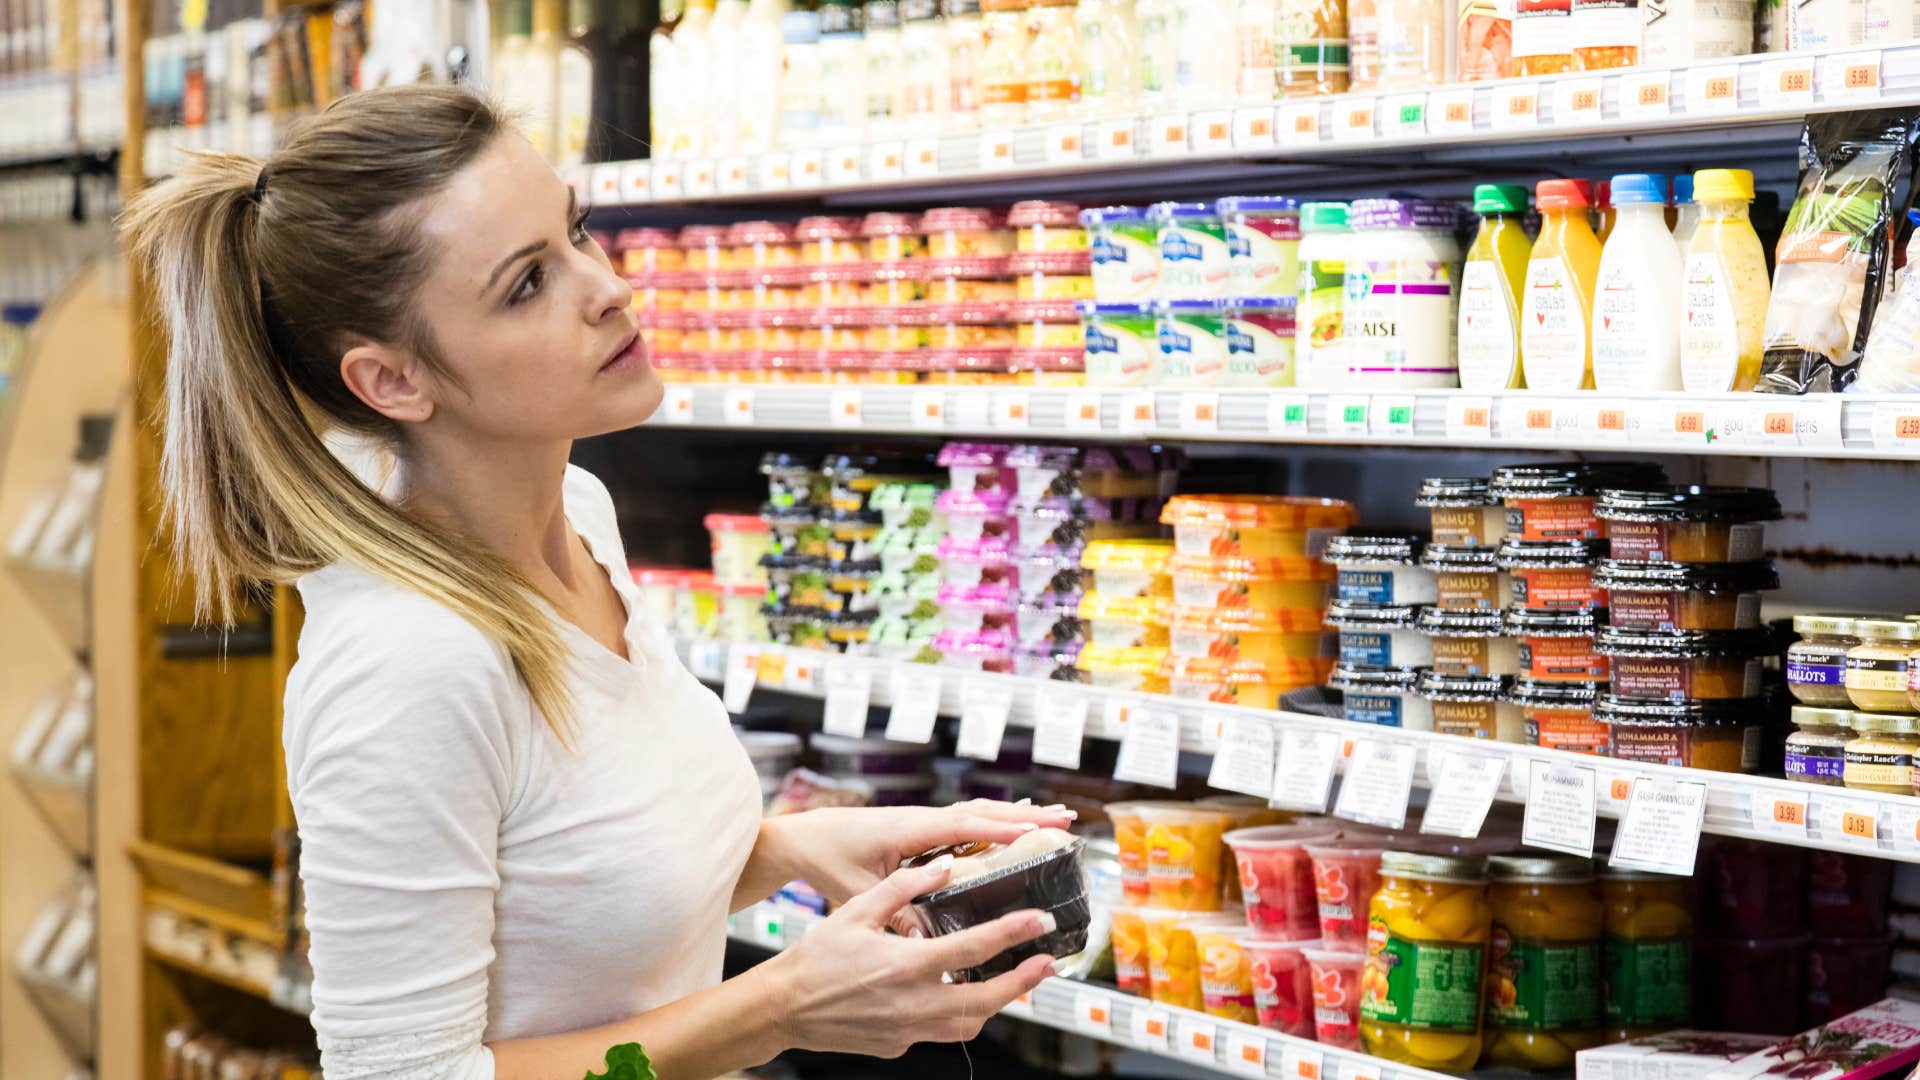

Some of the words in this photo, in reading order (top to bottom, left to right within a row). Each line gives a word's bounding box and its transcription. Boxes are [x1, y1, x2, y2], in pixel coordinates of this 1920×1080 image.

[1787, 75, 1804, 90] 5.99
[1851, 69, 1868, 85] 5.99
[1711, 82, 1728, 97] 5.99
[1680, 415, 1697, 432] 6.99
[1724, 418, 1744, 435] goo
[1769, 418, 1786, 433] 4.49
[1902, 419, 1920, 435] 2.59
[1618, 664, 1680, 674] MUHAMMARA
[1788, 669, 1826, 683] HALLOTS
[1616, 732, 1678, 742] MUHAMMARA
[1873, 754, 1896, 763] Ranch
[1779, 805, 1796, 821] 3.99
[1849, 816, 1866, 833] 3.19
